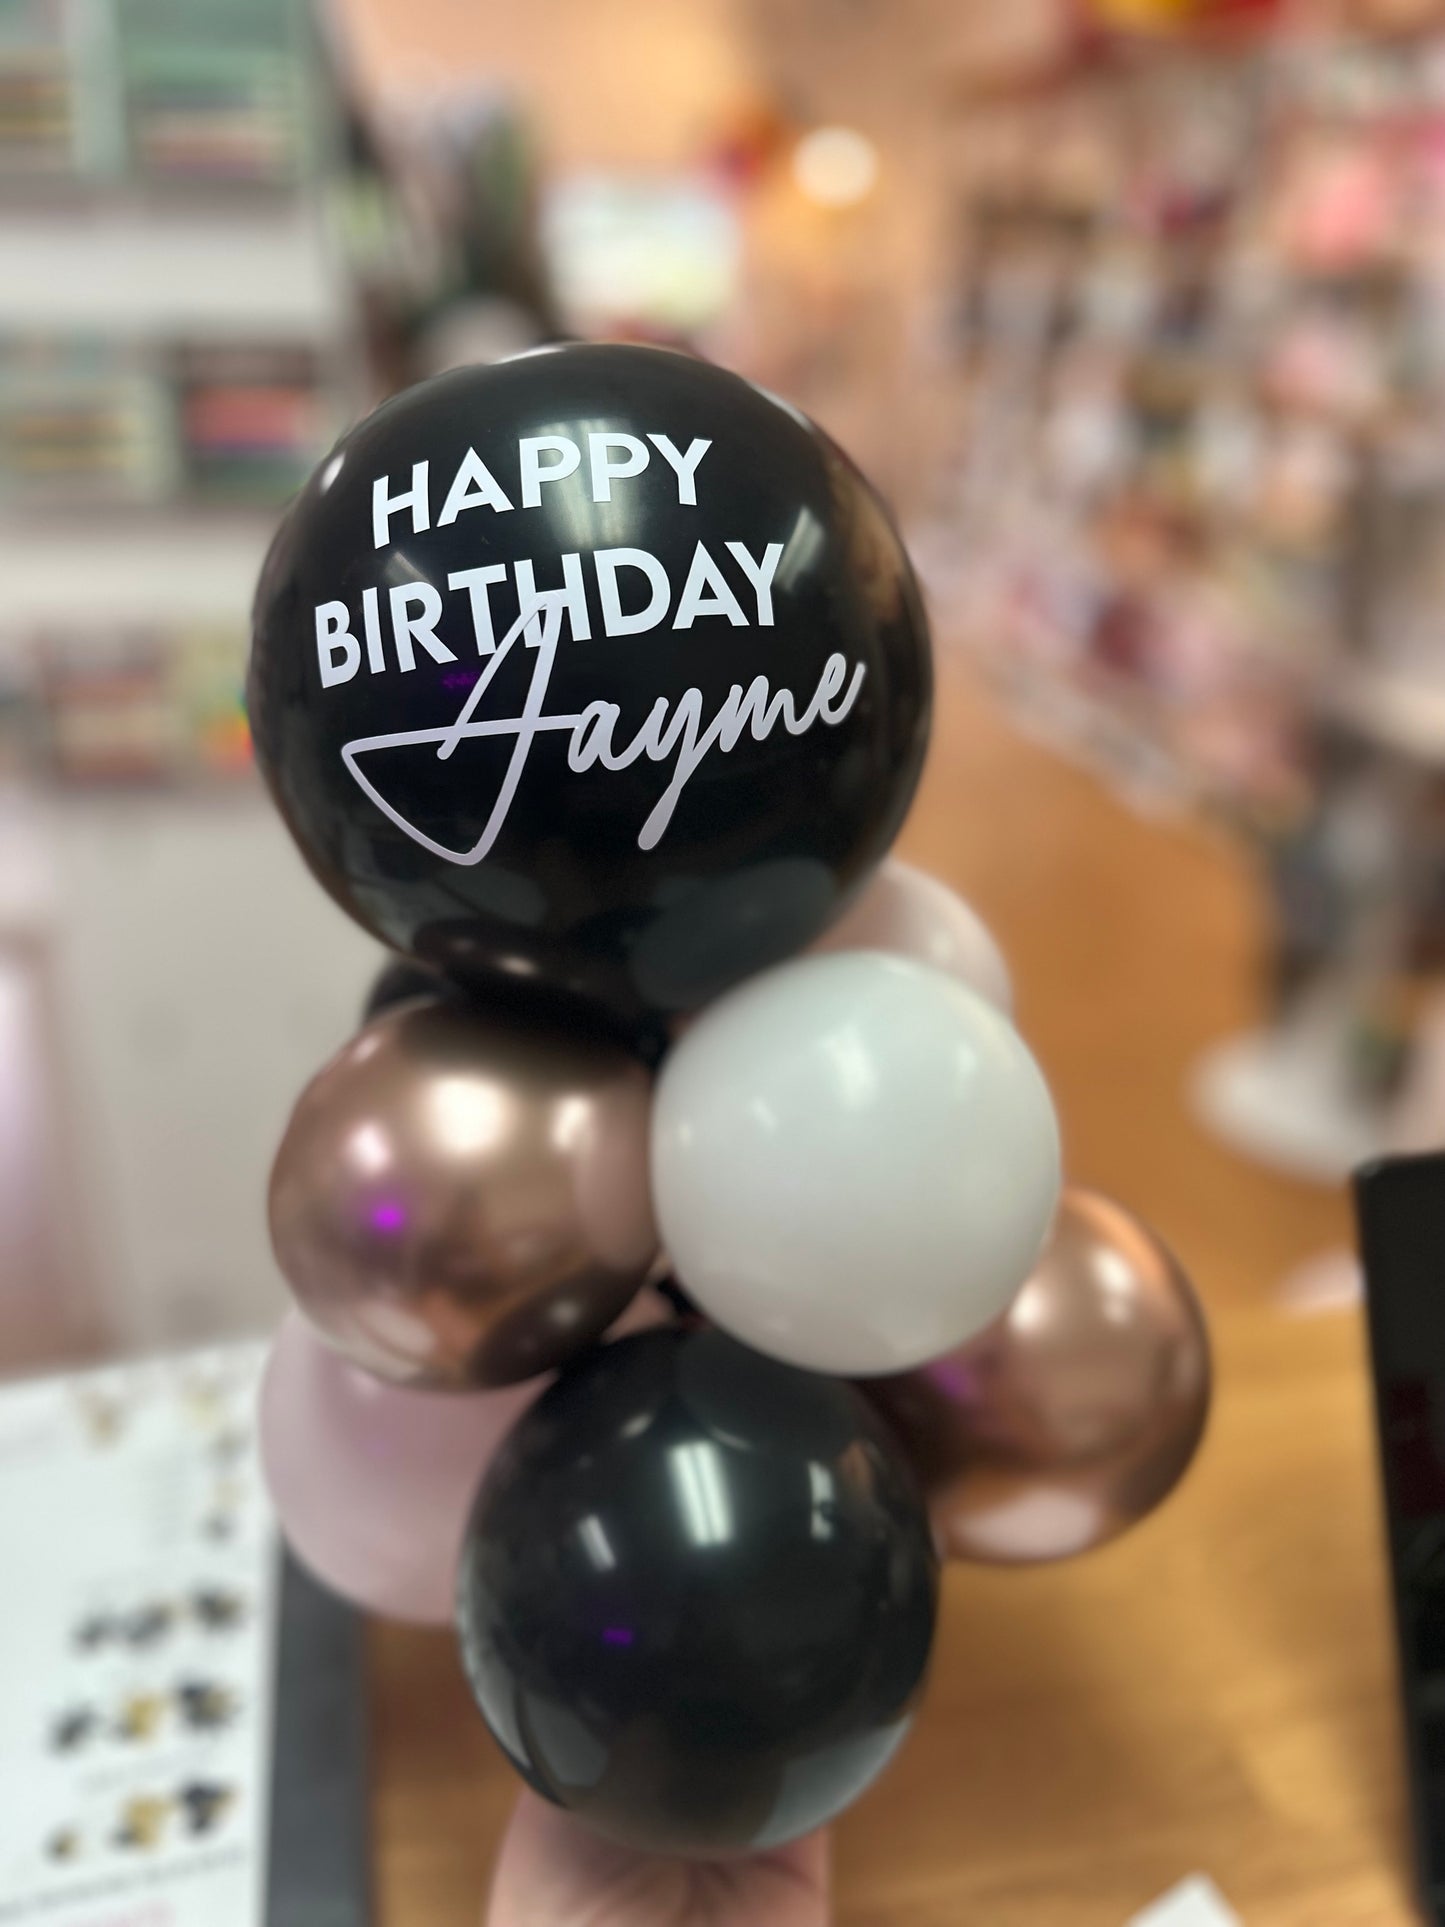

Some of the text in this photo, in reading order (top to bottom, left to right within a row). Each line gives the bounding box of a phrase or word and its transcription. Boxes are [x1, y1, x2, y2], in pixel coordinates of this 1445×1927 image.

[371, 432, 713, 549] HAPPY
[314, 539, 785, 689] BIRTHDAY
[341, 588, 866, 866] Jayme
